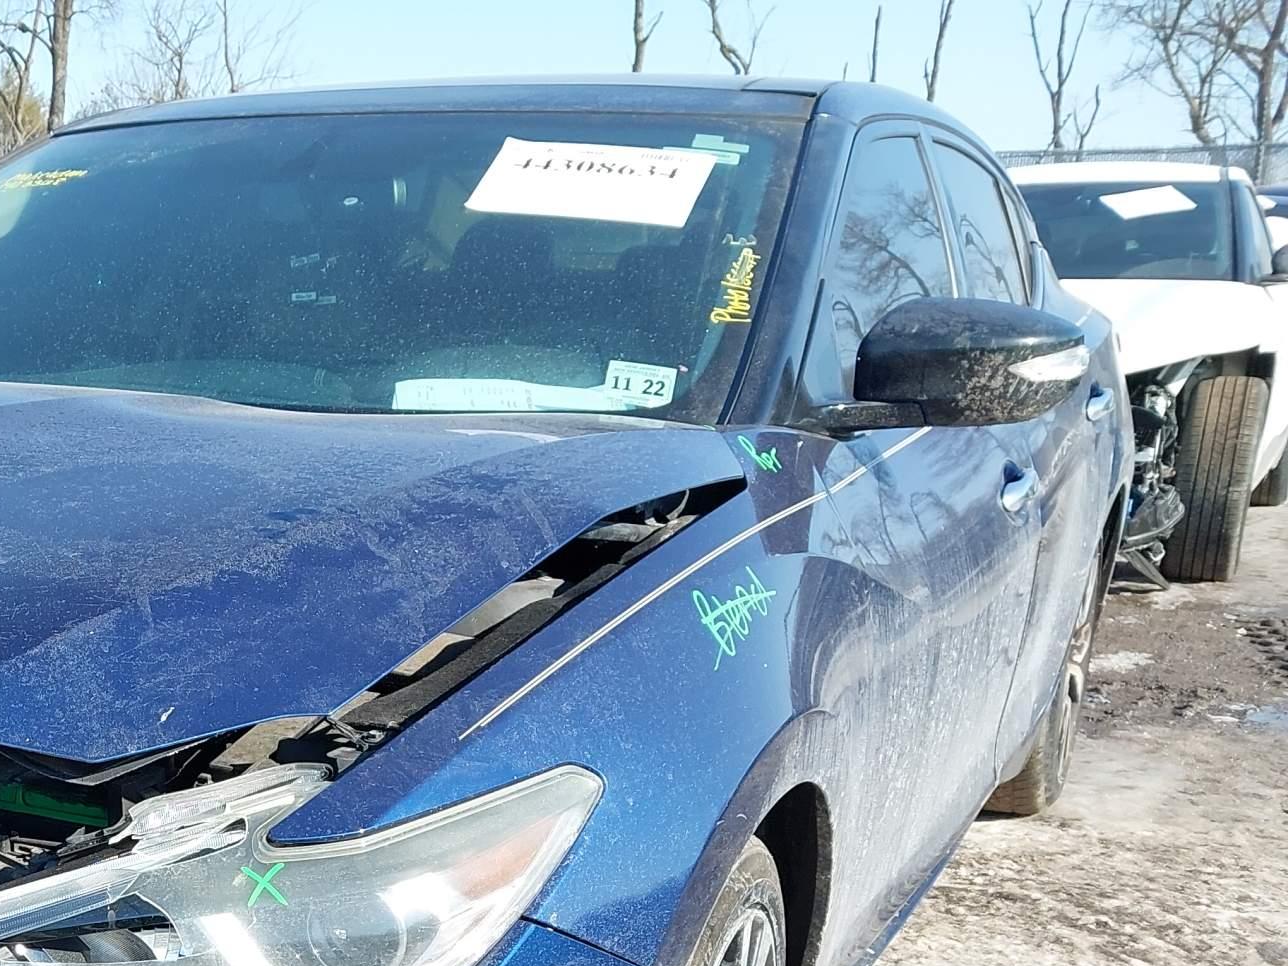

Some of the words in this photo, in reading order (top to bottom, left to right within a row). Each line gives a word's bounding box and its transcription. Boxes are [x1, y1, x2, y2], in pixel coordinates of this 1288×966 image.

[514, 157, 680, 179] 44308634
[611, 375, 632, 391] 11
[642, 378, 666, 397] 22
